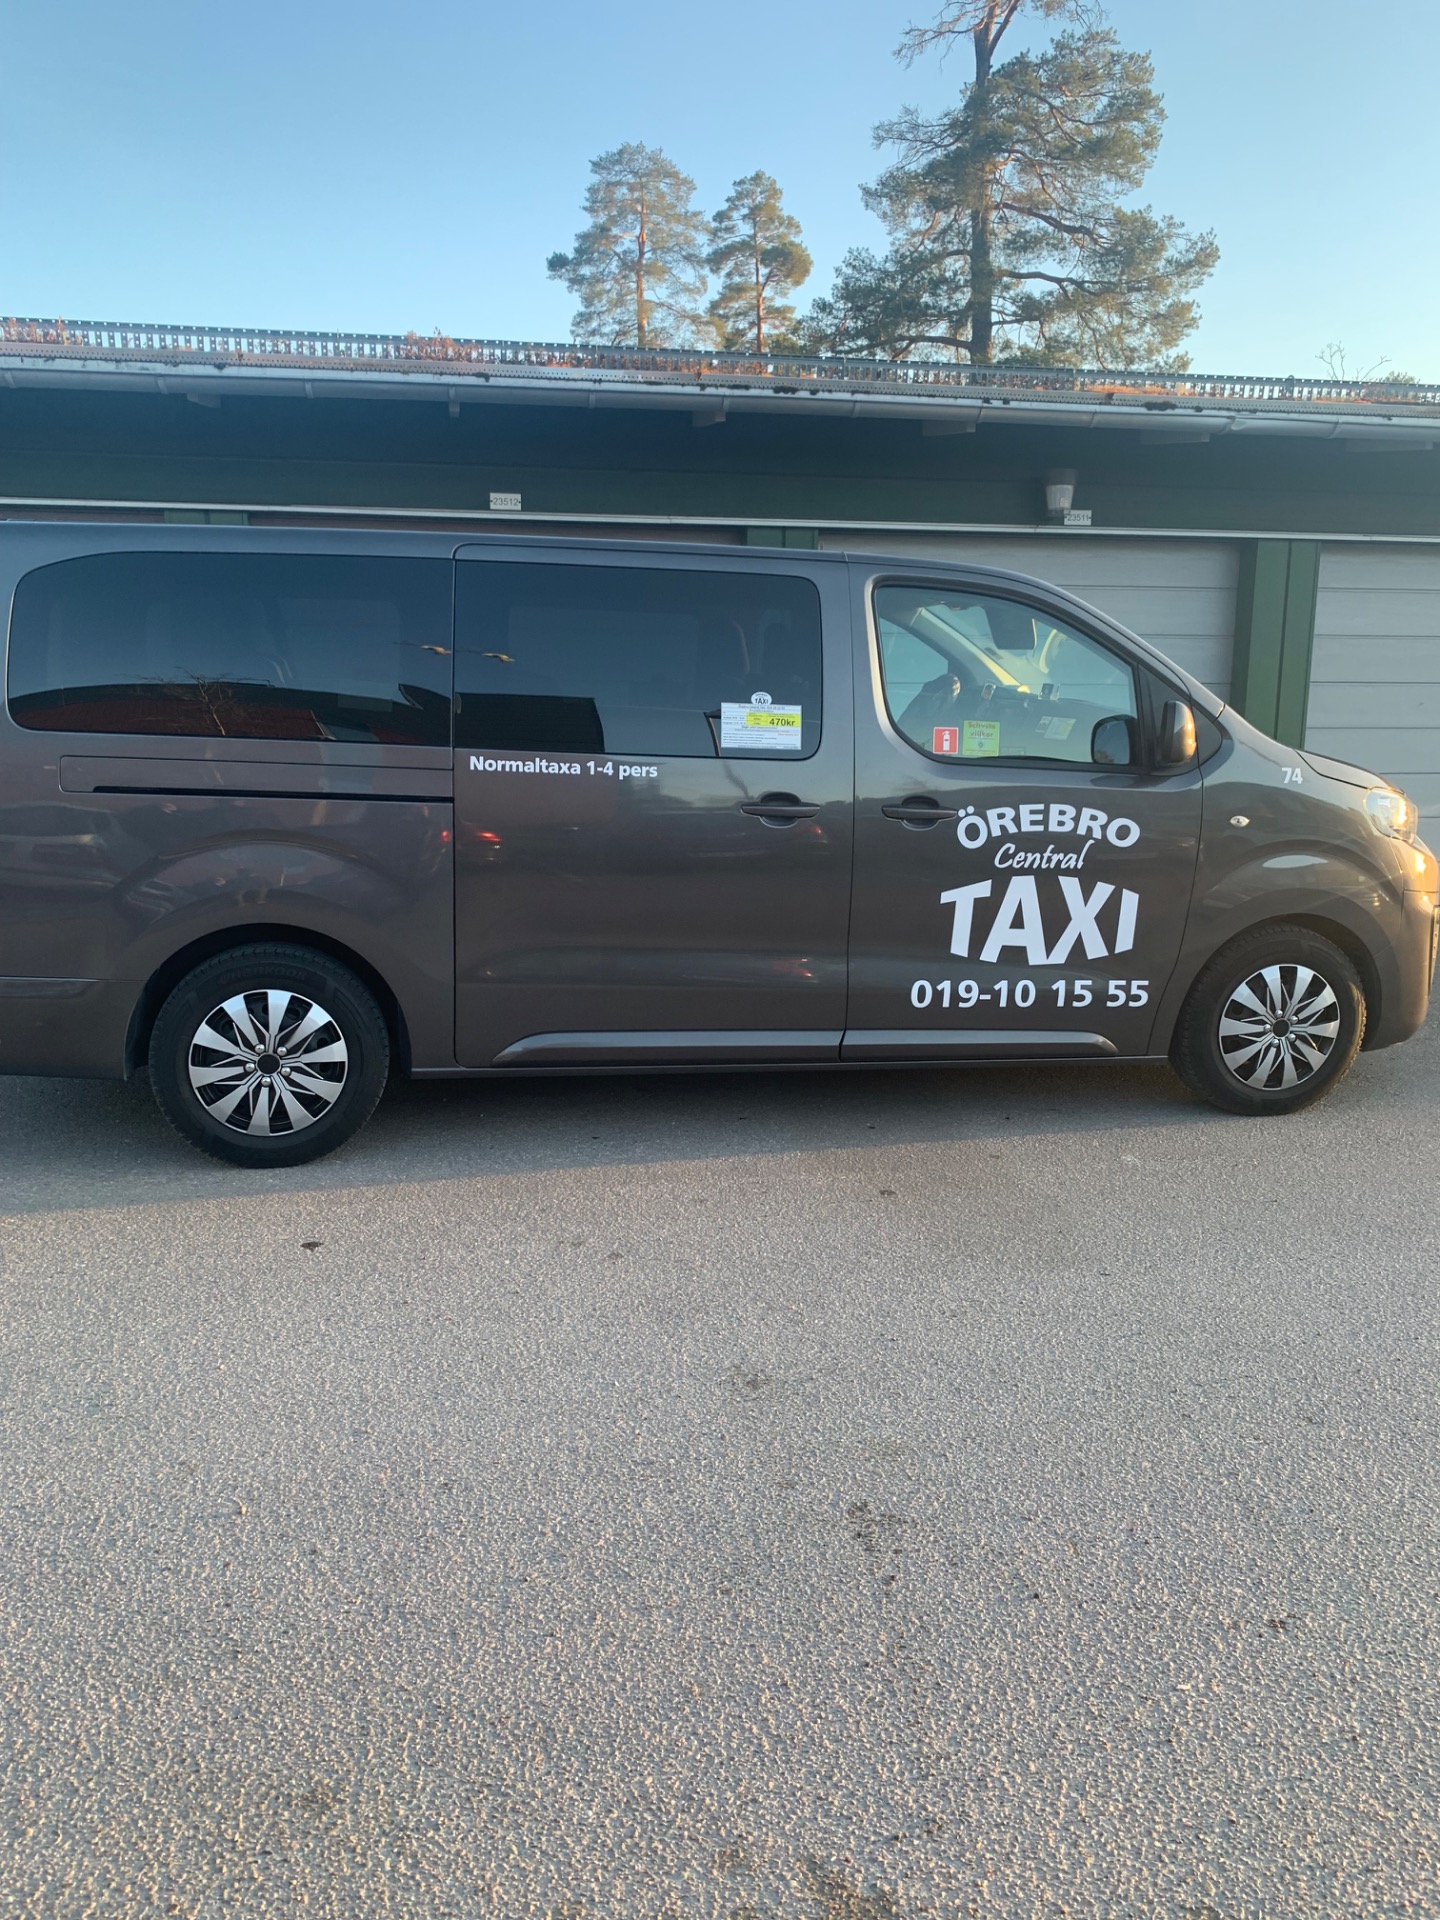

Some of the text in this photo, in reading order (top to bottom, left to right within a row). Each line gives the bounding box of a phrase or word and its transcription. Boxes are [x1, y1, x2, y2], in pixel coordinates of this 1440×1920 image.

[493, 497, 519, 506] 23512
[1067, 513, 1089, 521] 23511
[769, 717, 796, 727] 470kr
[469, 755, 658, 780] Normaltaxa 1-4 pers
[1281, 767, 1304, 784] 74
[956, 803, 1141, 850] ÖREBRO
[994, 839, 1095, 870] Central
[940, 874, 1140, 966] TAXI
[910, 979, 1150, 1009] 019-10 15 55
